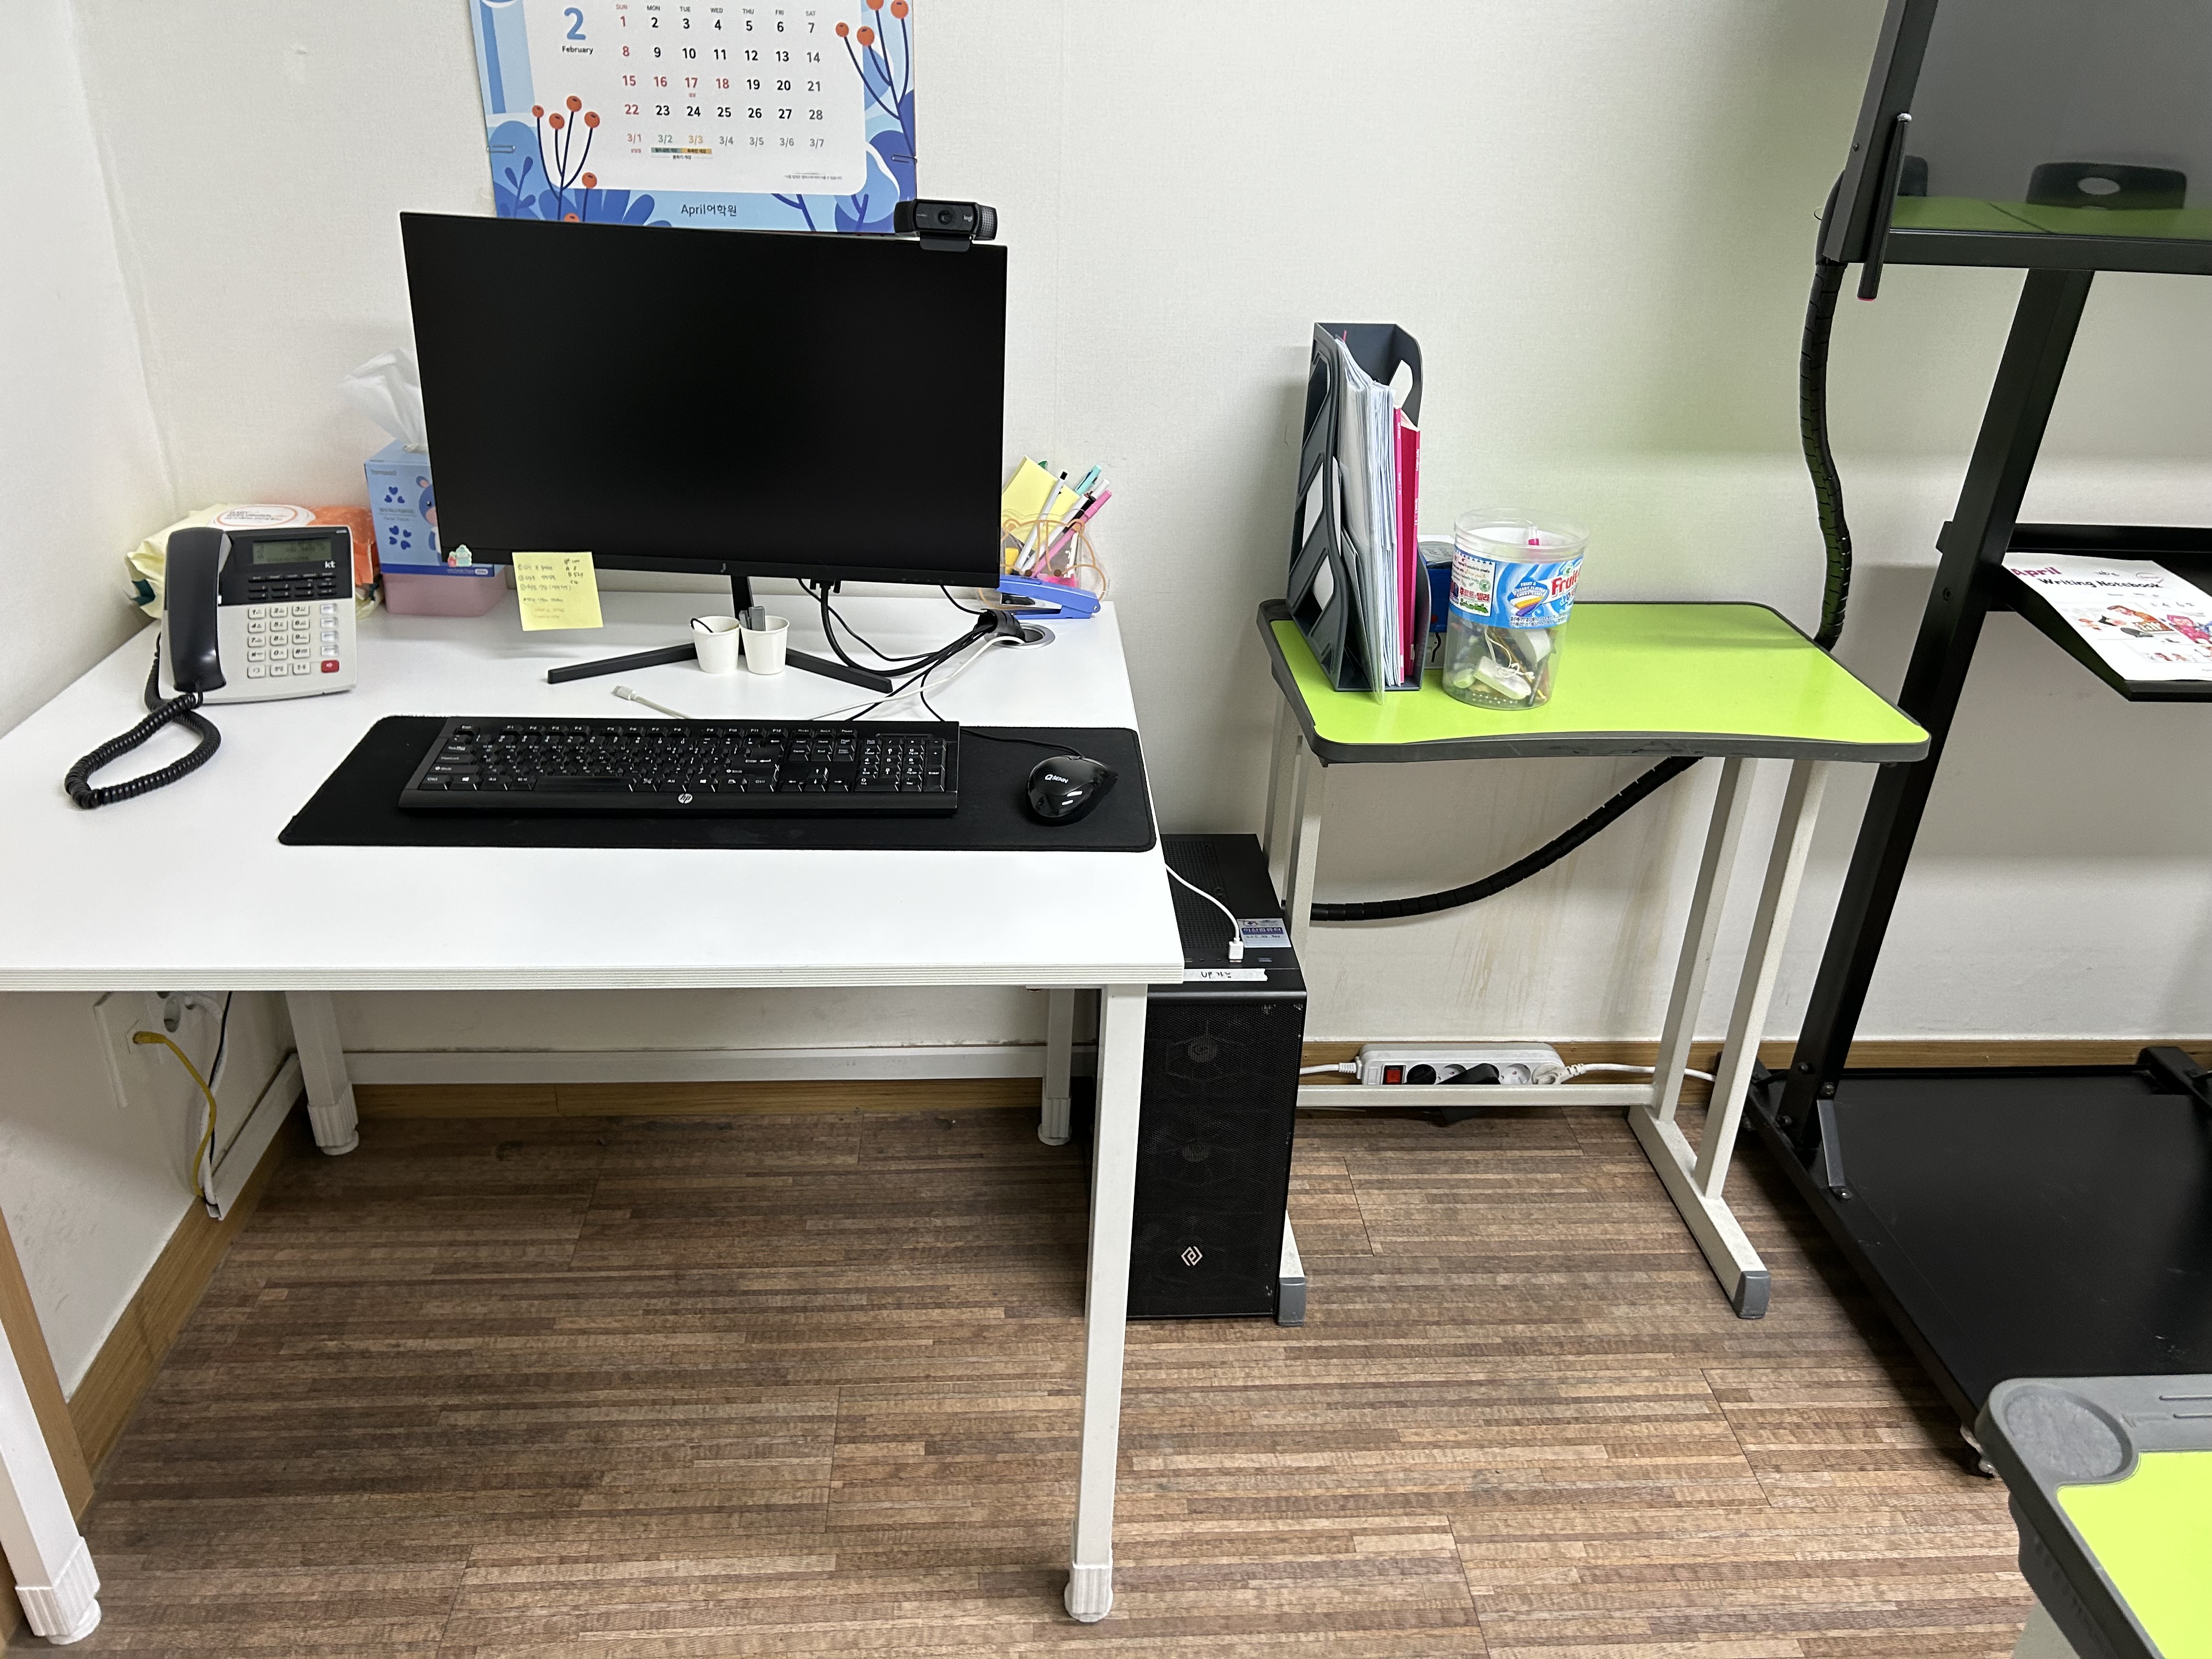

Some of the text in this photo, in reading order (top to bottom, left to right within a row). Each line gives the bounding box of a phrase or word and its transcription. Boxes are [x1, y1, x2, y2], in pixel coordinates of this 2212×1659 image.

[564, 8, 586, 40] 2
[620, 16, 815, 33] 1 2 3 4 5 6 7
[562, 46, 594, 54] February
[623, 46, 820, 63] 8 9 10 11 12 13 14
[623, 75, 820, 92] 15 16 17 18 19 20 21
[624, 104, 823, 120] 22 23 24 25 26 27 28
[628, 133, 823, 149] 3/1 3/2 3/3 3/4 3/5 3/6 3/7
[681, 204, 737, 217] April어학원
[2010, 567, 2062, 577] April
[2036, 578, 2097, 588] Writing
[1045, 774, 1069, 784] QSENN
[1201, 971, 1212, 979] UP
